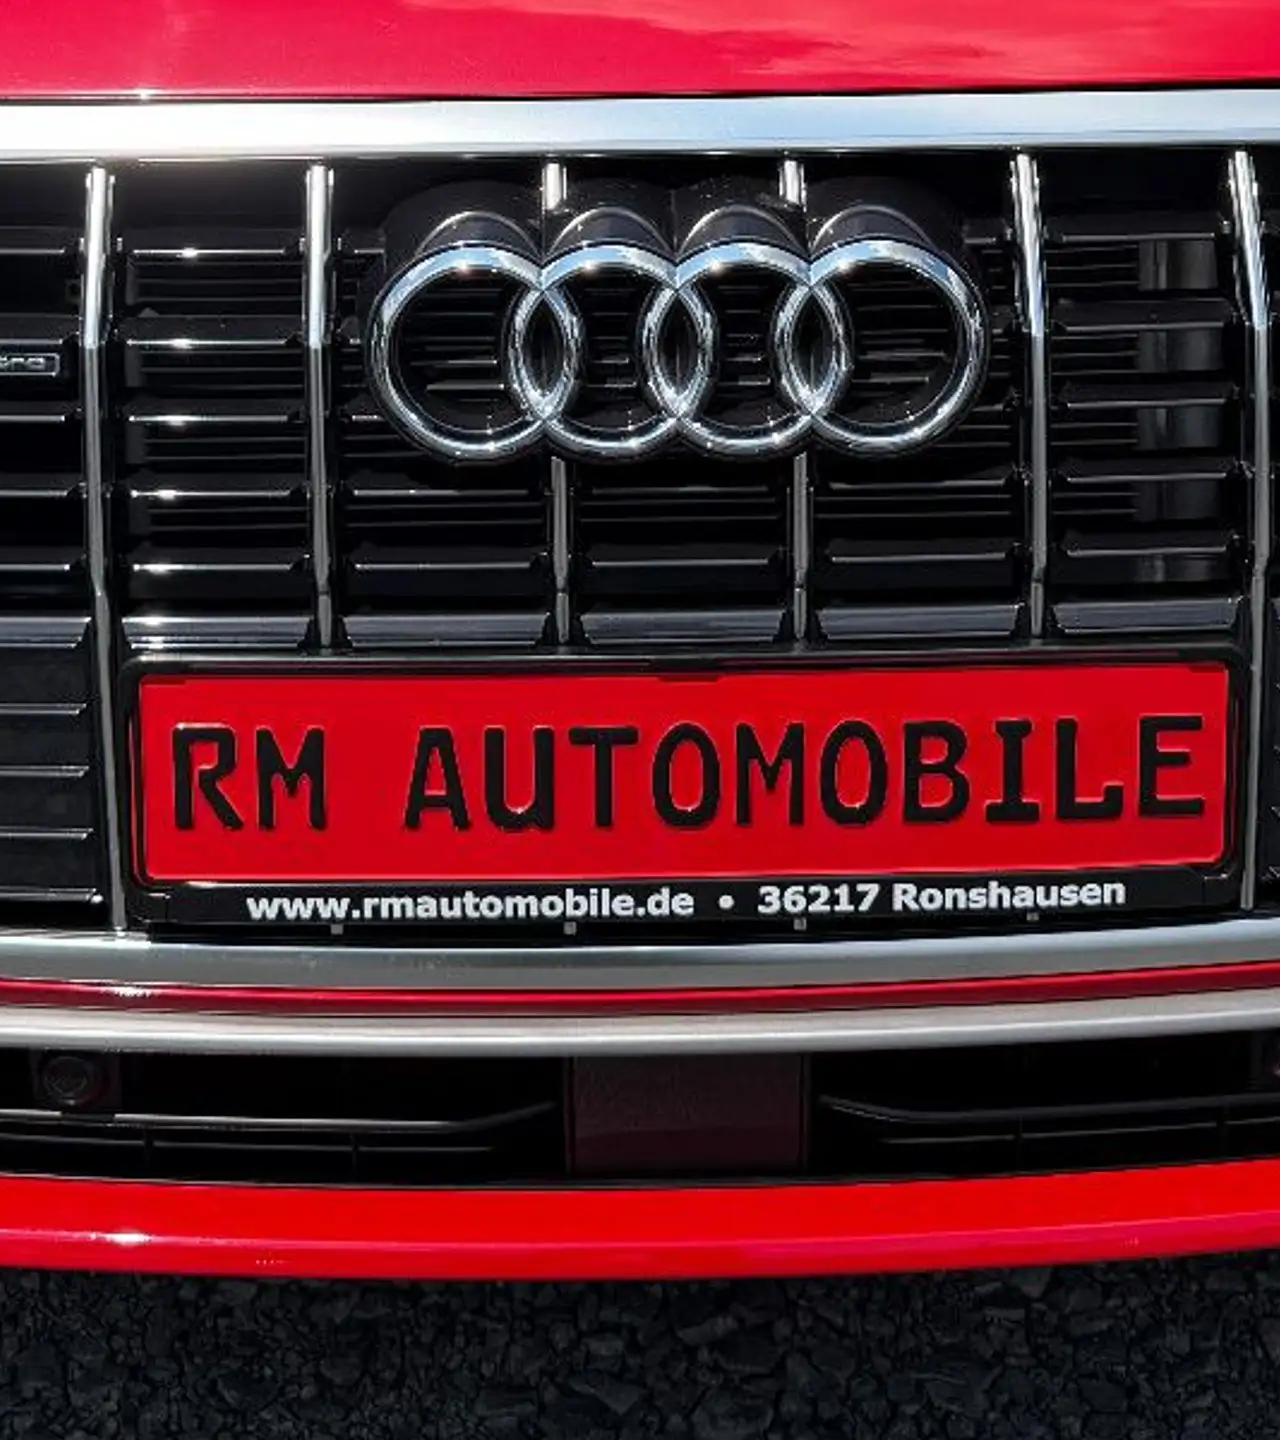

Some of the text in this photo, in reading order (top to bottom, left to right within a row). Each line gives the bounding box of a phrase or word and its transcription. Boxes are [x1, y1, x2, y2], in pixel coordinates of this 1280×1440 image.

[171, 714, 1205, 831] RM AUTOMOBILE
[246, 880, 1127, 920] www.rmautomobile.de 36217 Ronshausen
